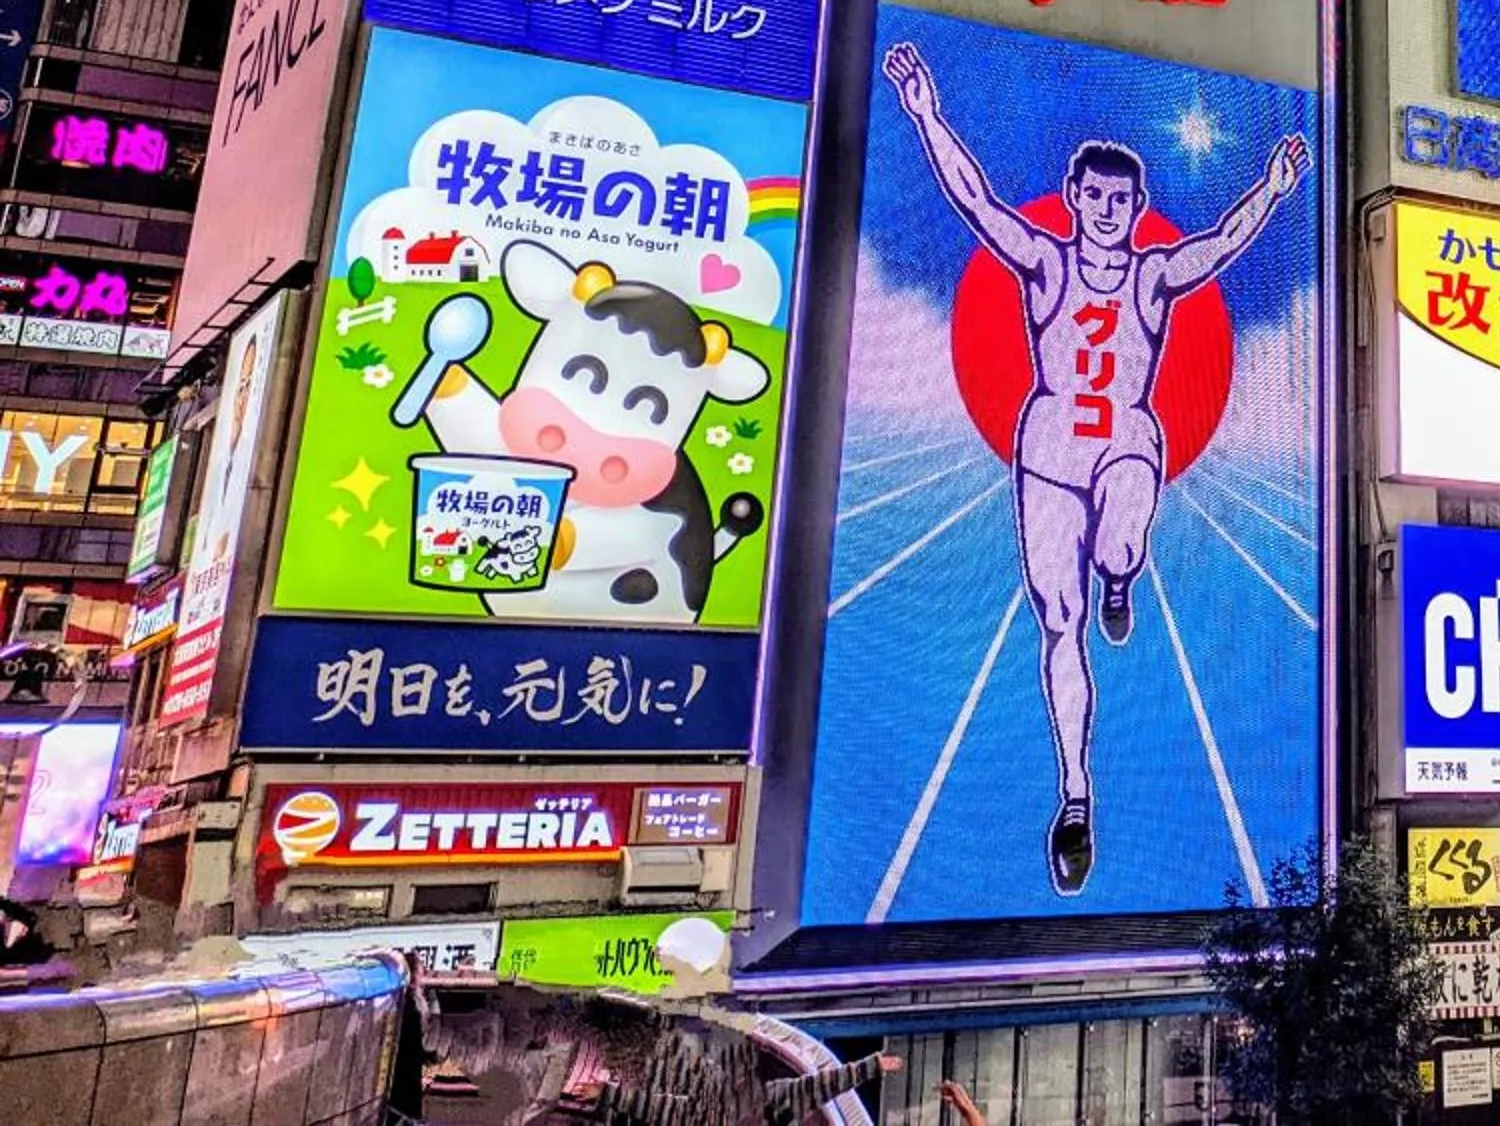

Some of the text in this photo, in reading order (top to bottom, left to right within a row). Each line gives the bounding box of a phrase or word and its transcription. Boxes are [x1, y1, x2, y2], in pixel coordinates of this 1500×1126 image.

[548, 130, 643, 159] まきばのあさ
[436, 137, 733, 244] 牧場の朝
[485, 212, 681, 256] Makiba no Asa Yogurt
[1072, 298, 1122, 439] グリコ
[434, 487, 544, 520] 牧場の朝
[460, 516, 512, 531] ヨーグルト
[350, 802, 614, 852] ZETTERIA
[667, 825, 720, 840] コーヒー
